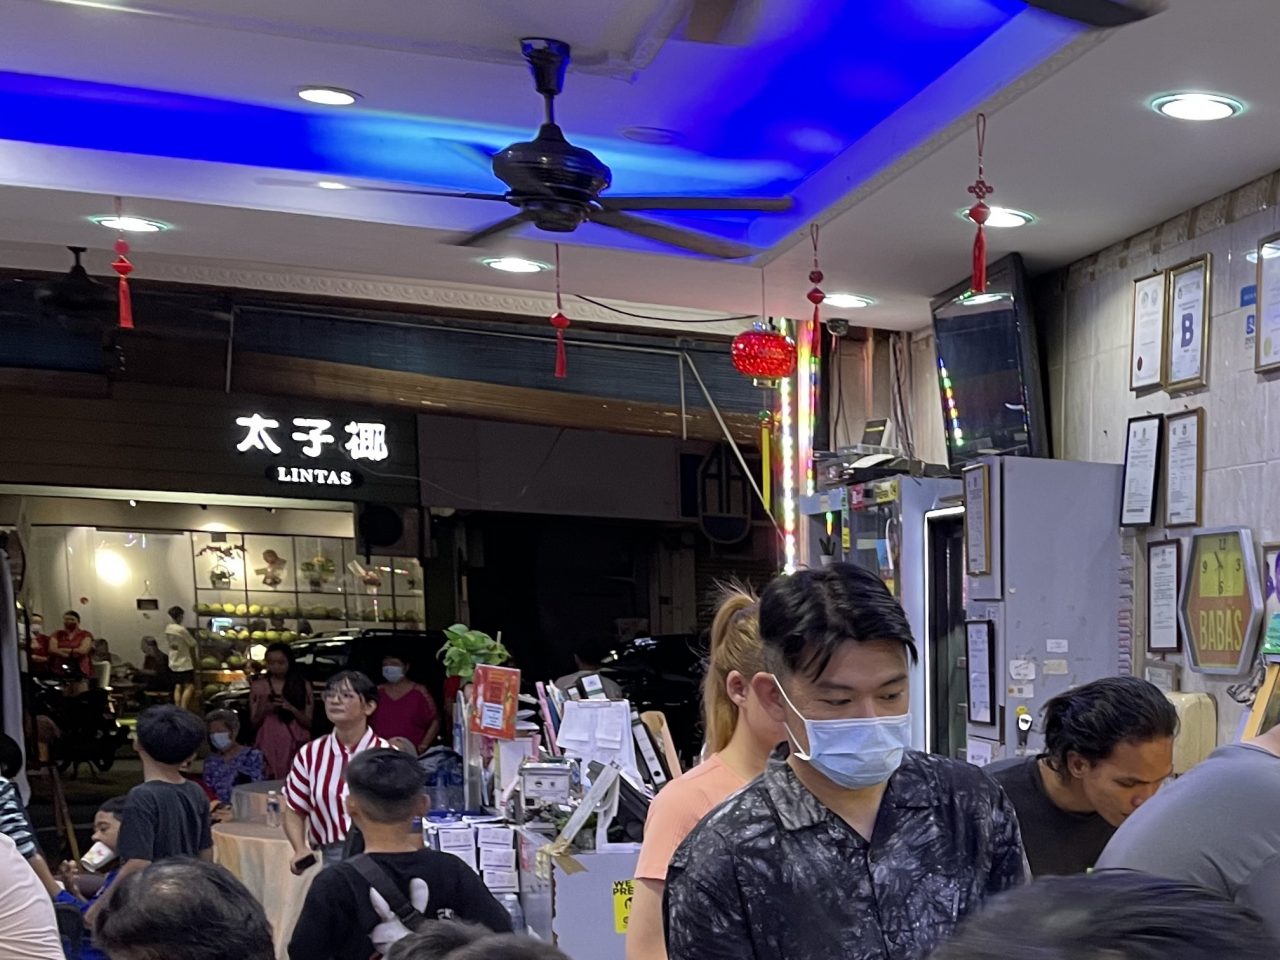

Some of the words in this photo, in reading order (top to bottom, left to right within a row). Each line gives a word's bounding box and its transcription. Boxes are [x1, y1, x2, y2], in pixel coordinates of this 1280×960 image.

[1181, 313, 1194, 348] B
[277, 467, 352, 485] LINTAS
[1236, 558, 1241, 571] 3
